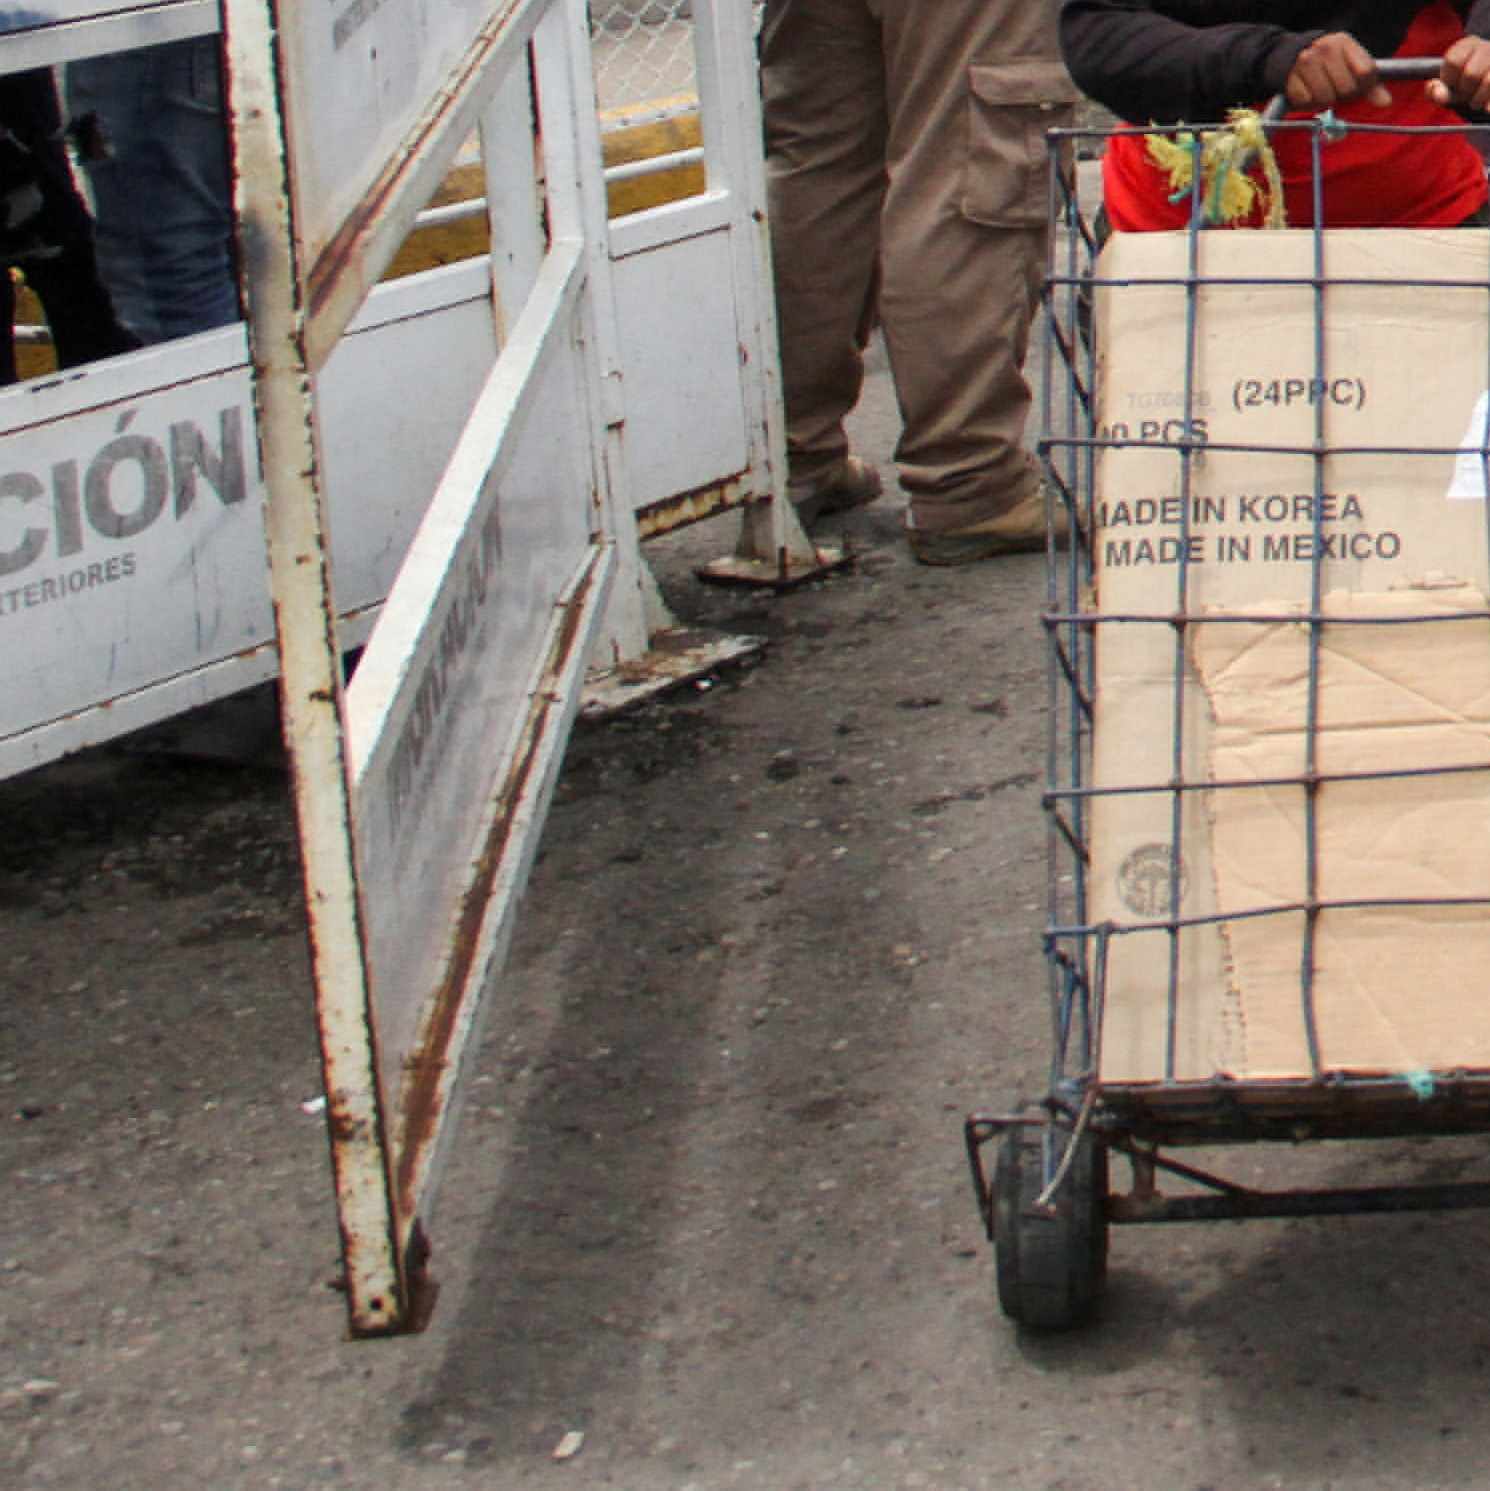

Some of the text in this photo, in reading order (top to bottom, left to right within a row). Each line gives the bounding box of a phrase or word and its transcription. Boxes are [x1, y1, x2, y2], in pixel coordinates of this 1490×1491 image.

[1193, 495, 1226, 524] IN
[1239, 493, 1364, 523] KOREA
[1104, 531, 1402, 567] MADE IN MEXICO
